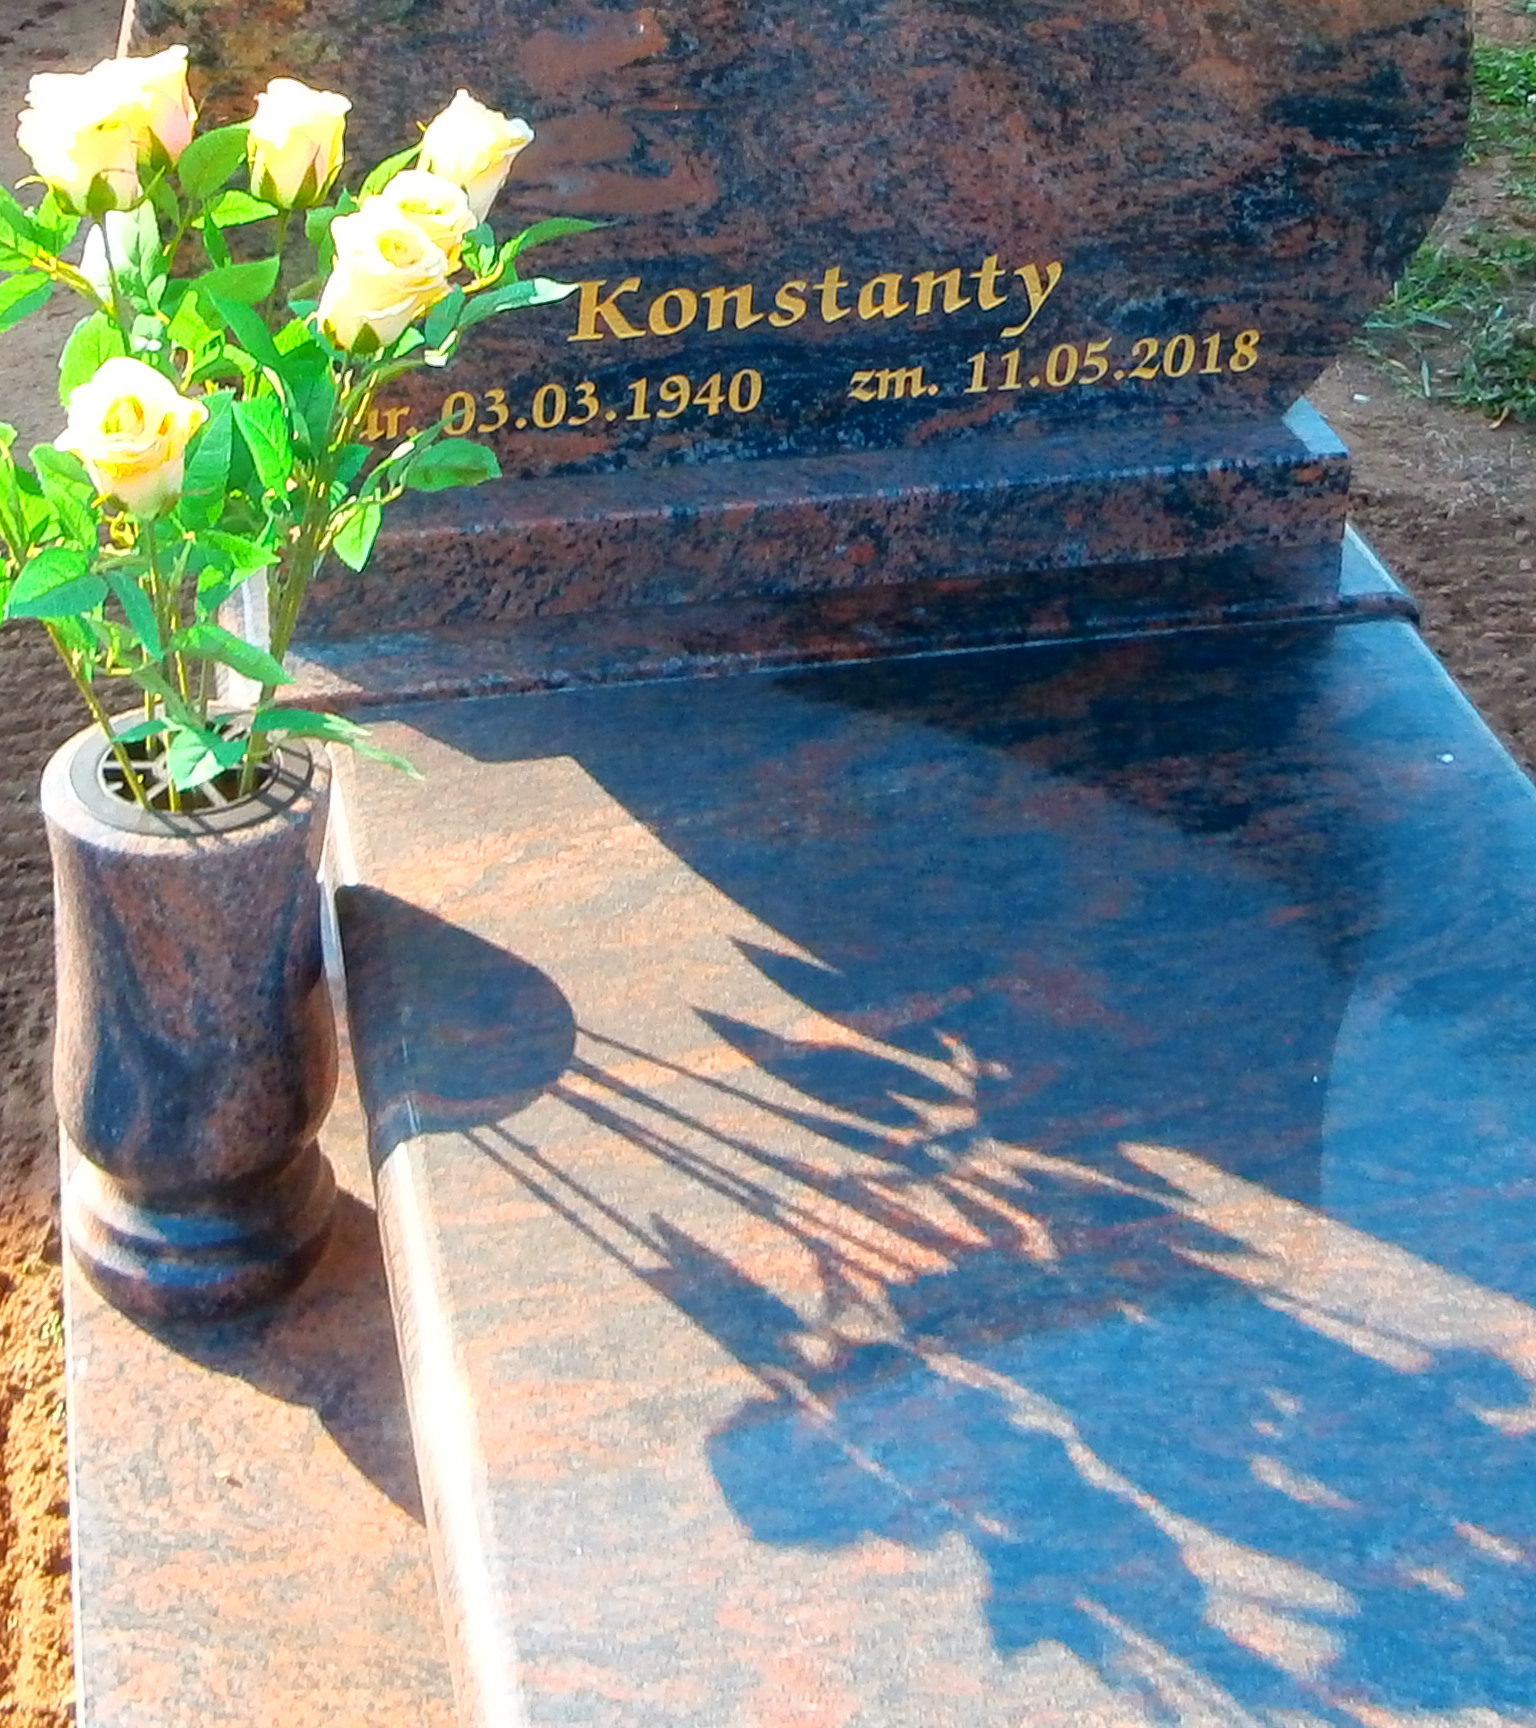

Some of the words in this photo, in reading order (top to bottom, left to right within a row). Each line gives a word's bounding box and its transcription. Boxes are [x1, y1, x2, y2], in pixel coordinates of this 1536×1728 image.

[566, 253, 1064, 342] Konstanty
[441, 368, 763, 436] 03.03.1940
[847, 364, 940, 403] zm.
[963, 327, 1262, 394] 11.05.2018
